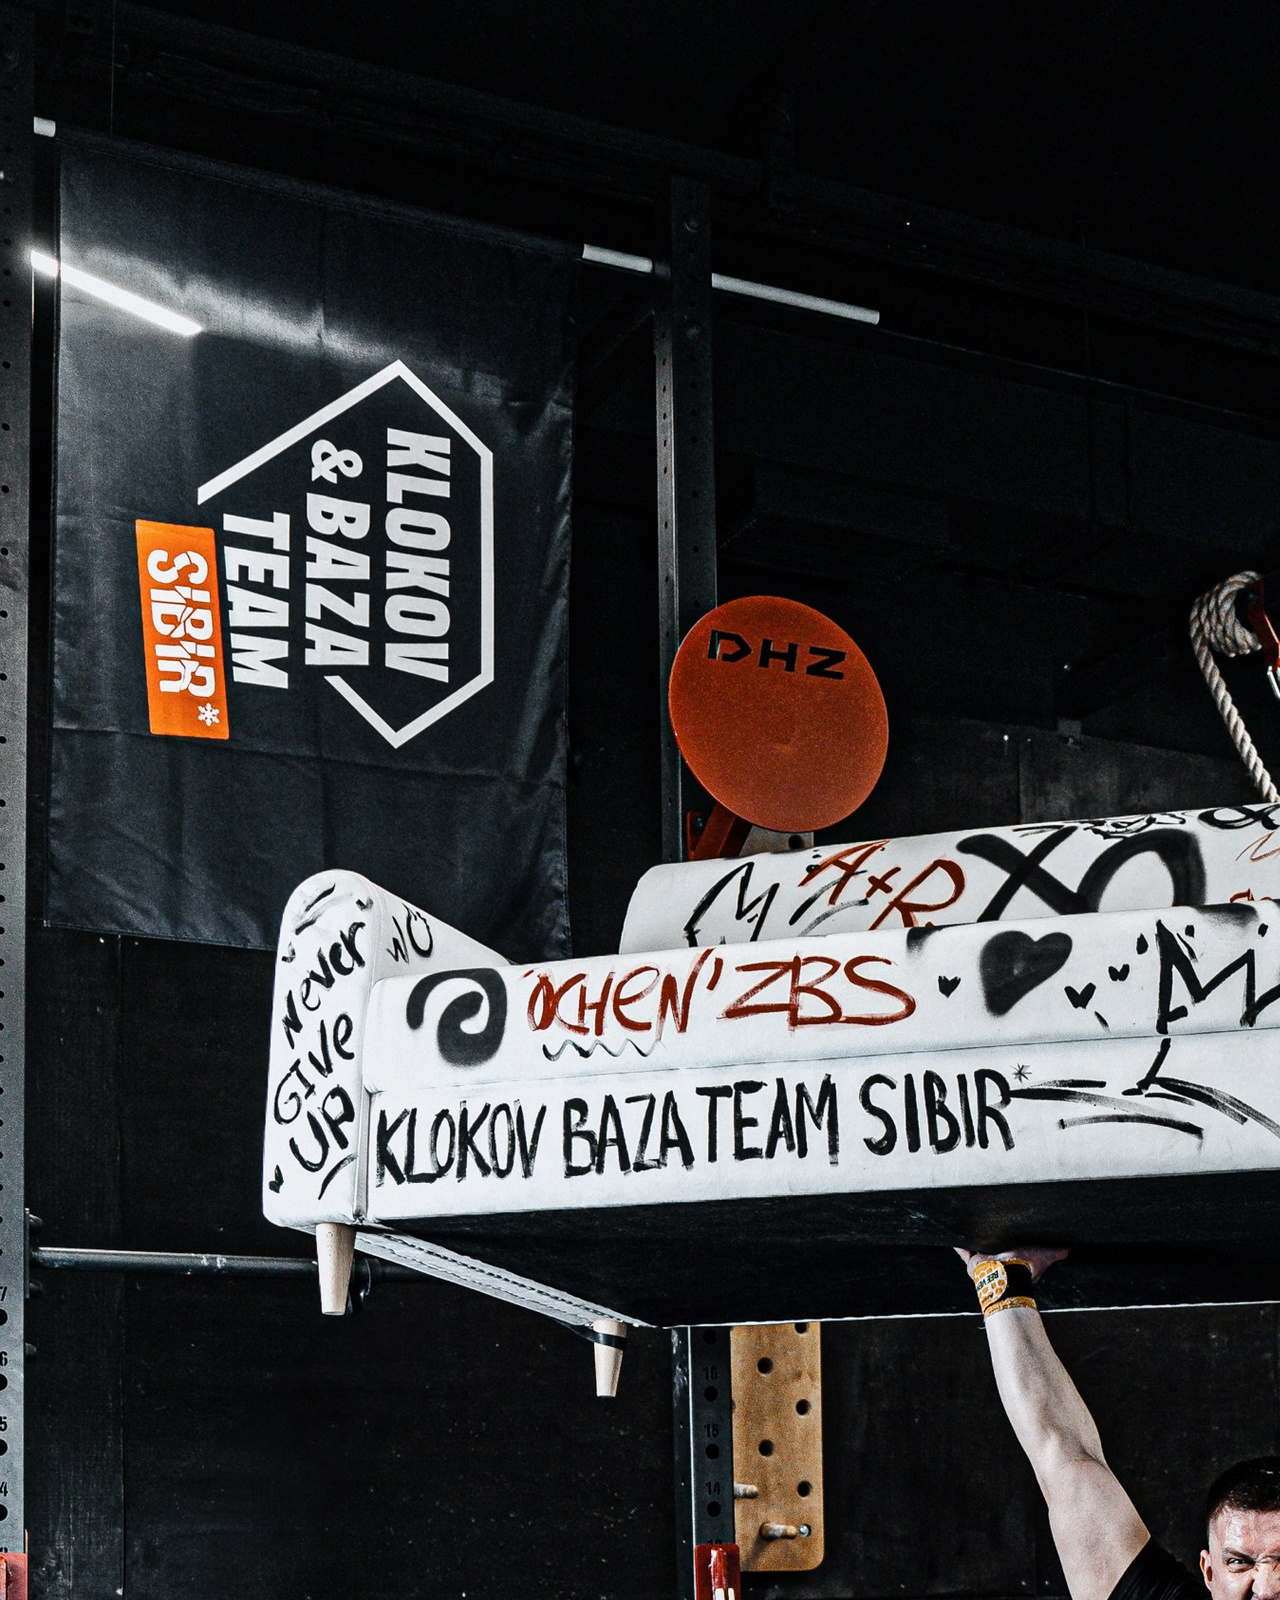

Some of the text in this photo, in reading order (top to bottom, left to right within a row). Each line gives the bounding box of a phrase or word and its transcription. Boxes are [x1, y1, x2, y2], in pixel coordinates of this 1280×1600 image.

[223, 511, 290, 689] TEAM
[305, 439, 370, 666] & BAZA
[385, 428, 450, 683] KLOKOV
[147, 549, 216, 697] SIBIR
[707, 629, 847, 681] DHZ
[717, 951, 916, 1036] ZBS
[289, 1084, 355, 1172] UP
[376, 1099, 547, 1187] KLOKOV
